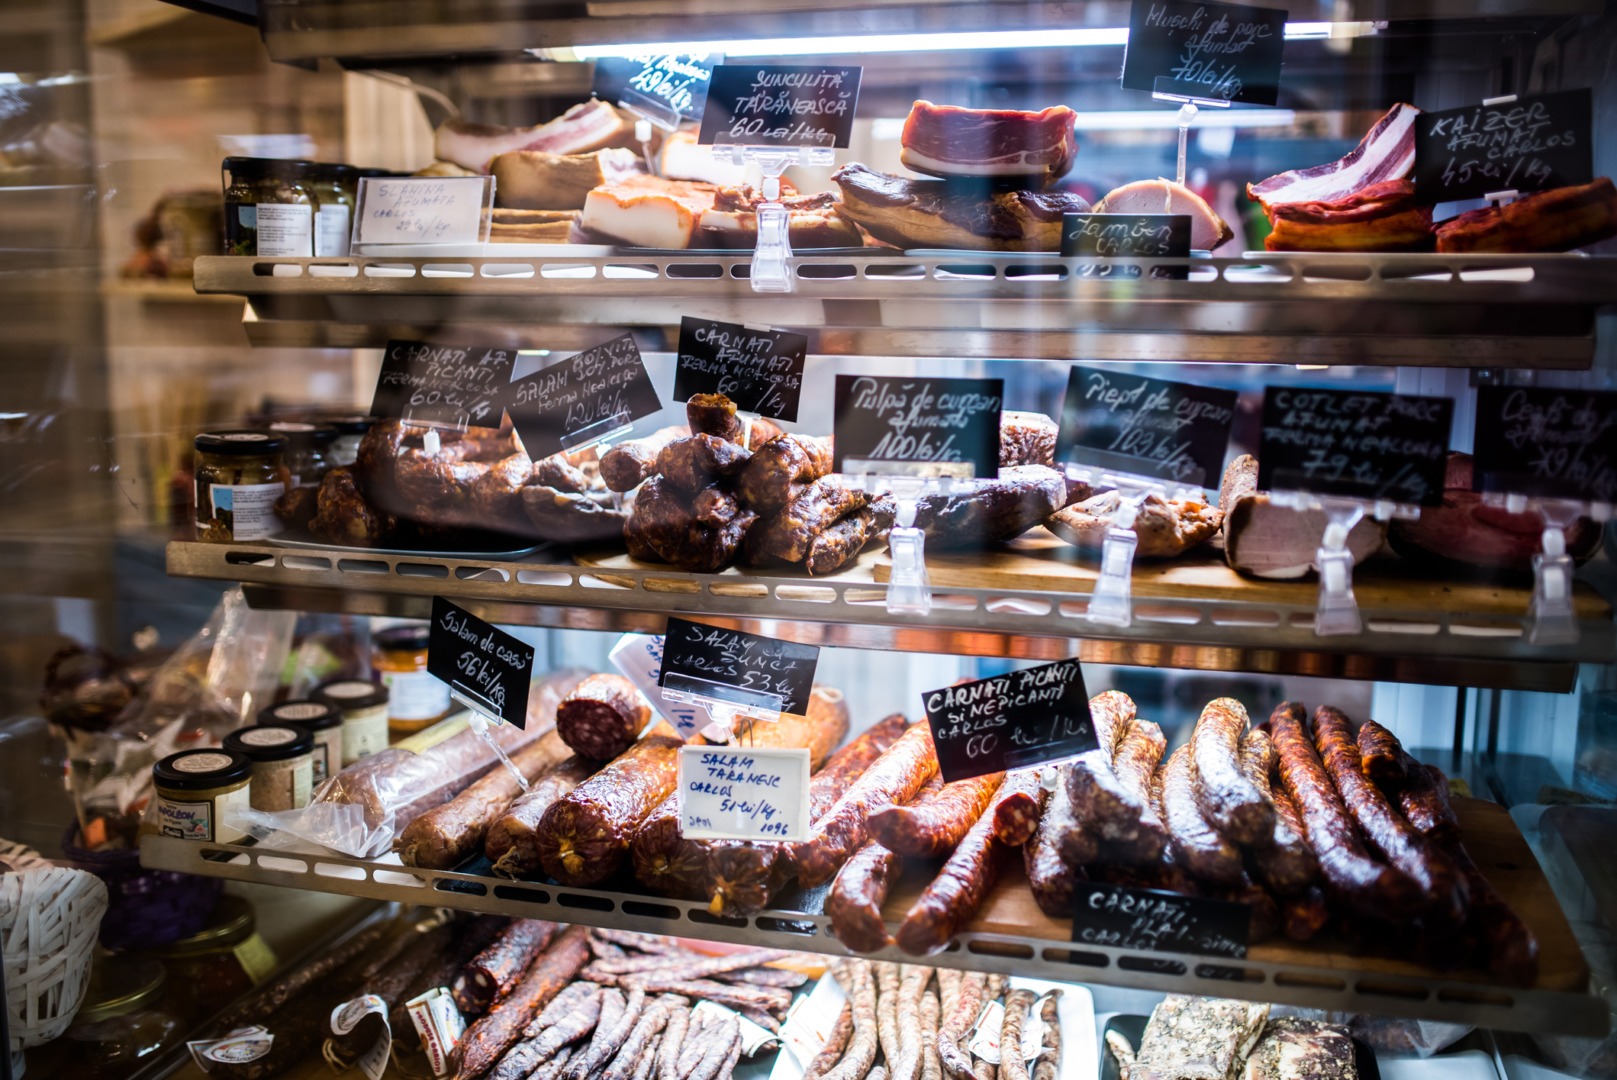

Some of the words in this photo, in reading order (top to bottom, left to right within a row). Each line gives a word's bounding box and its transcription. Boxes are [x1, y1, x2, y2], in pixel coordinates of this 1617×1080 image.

[410, 387, 442, 405] 60
[440, 611, 479, 645] Salam
[480, 632, 495, 654] de
[966, 733, 998, 759] 60
[701, 753, 755, 769] SALAM
[707, 767, 781, 788] TARANESC
[689, 781, 733, 797] CARLOS
[760, 822, 789, 836] 1096
